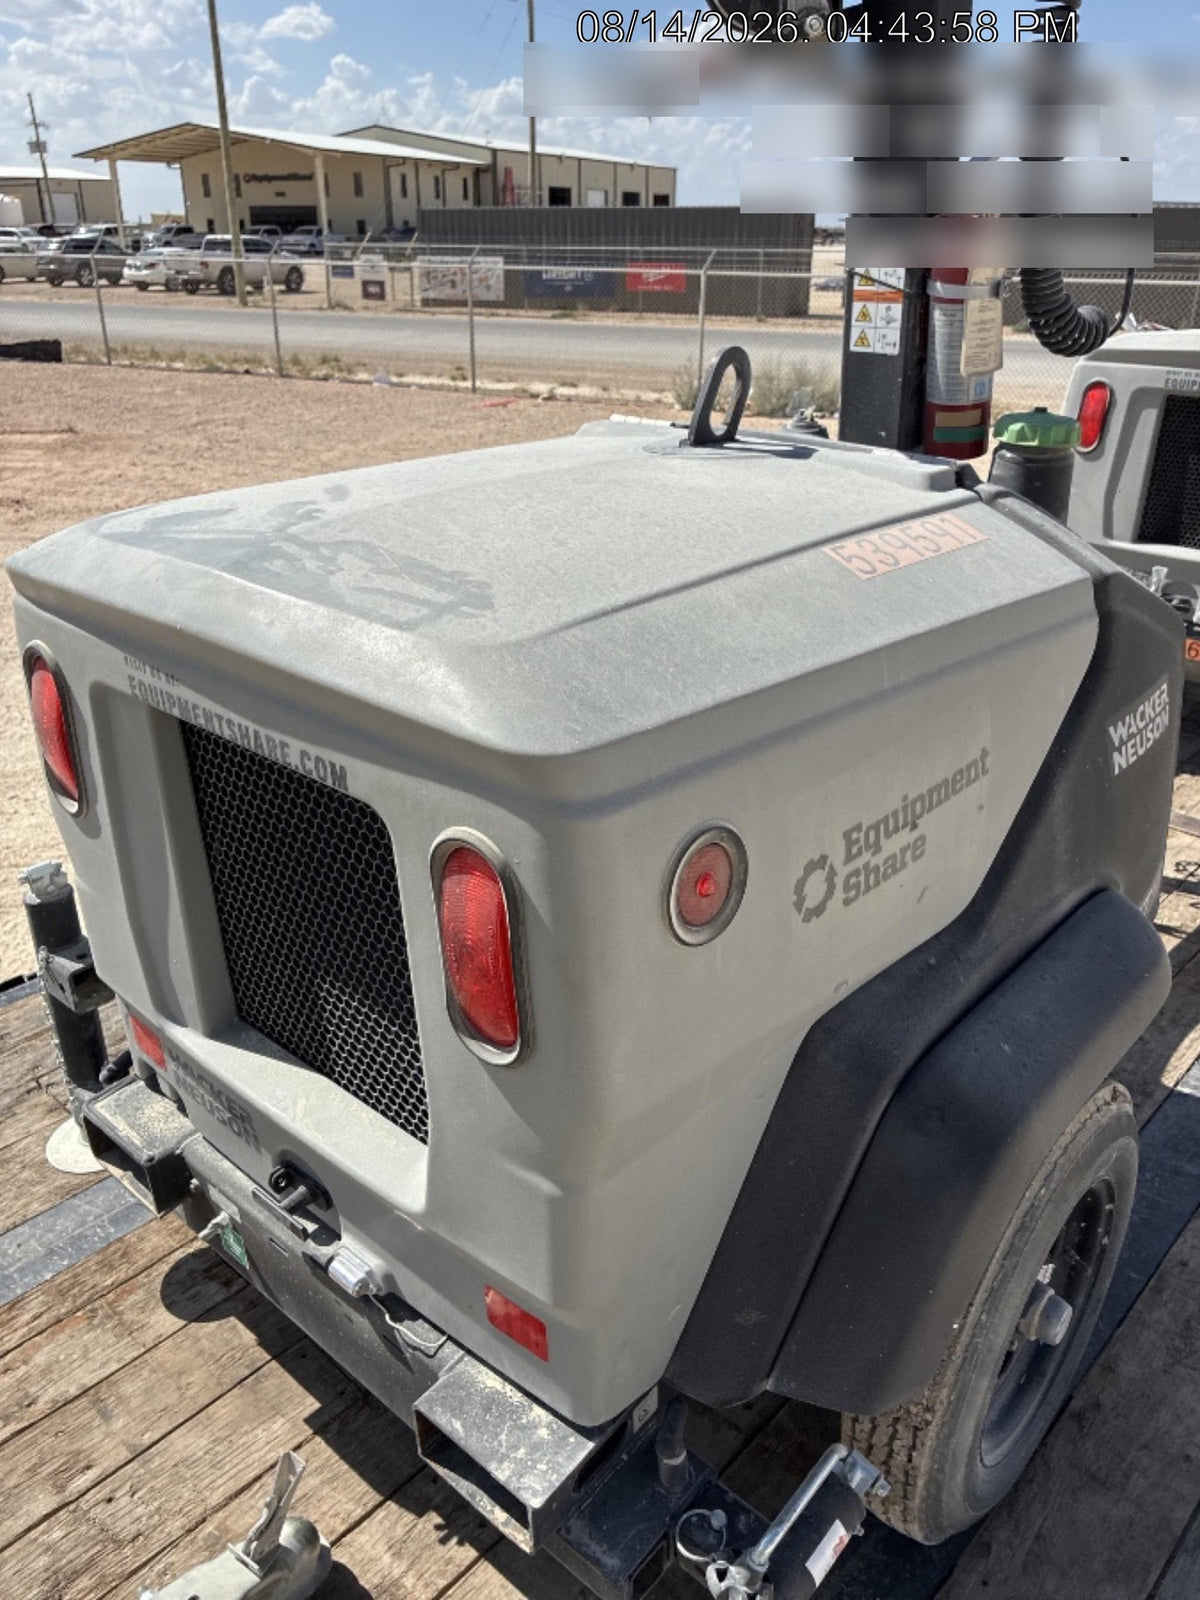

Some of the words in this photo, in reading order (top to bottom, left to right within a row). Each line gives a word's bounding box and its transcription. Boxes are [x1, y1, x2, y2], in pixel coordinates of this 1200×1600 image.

[831, 517, 977, 575] 539591
[128, 674, 348, 792] EQUIPMENTSHARE.COM
[1108, 682, 1169, 747] WACKER
[1113, 704, 1169, 776] NEUSON
[842, 747, 990, 866] Equipment
[842, 833, 928, 908] Share
